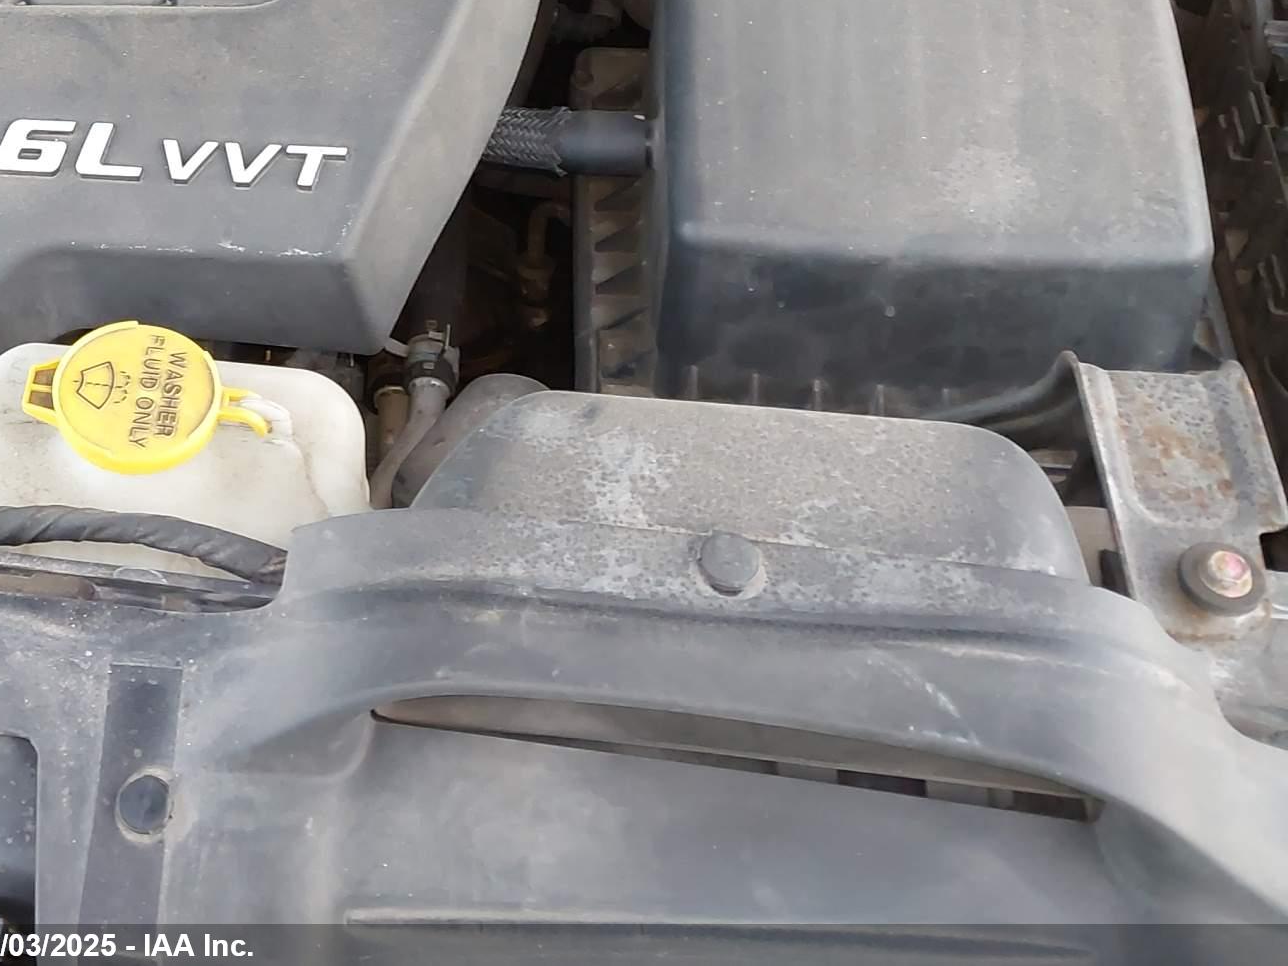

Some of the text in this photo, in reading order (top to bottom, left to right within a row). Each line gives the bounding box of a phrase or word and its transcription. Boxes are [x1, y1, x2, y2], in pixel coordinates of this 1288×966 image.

[161, 138, 349, 192] VVT
[128, 334, 166, 448] FLUID ONLY
[155, 351, 188, 439] WASHER
